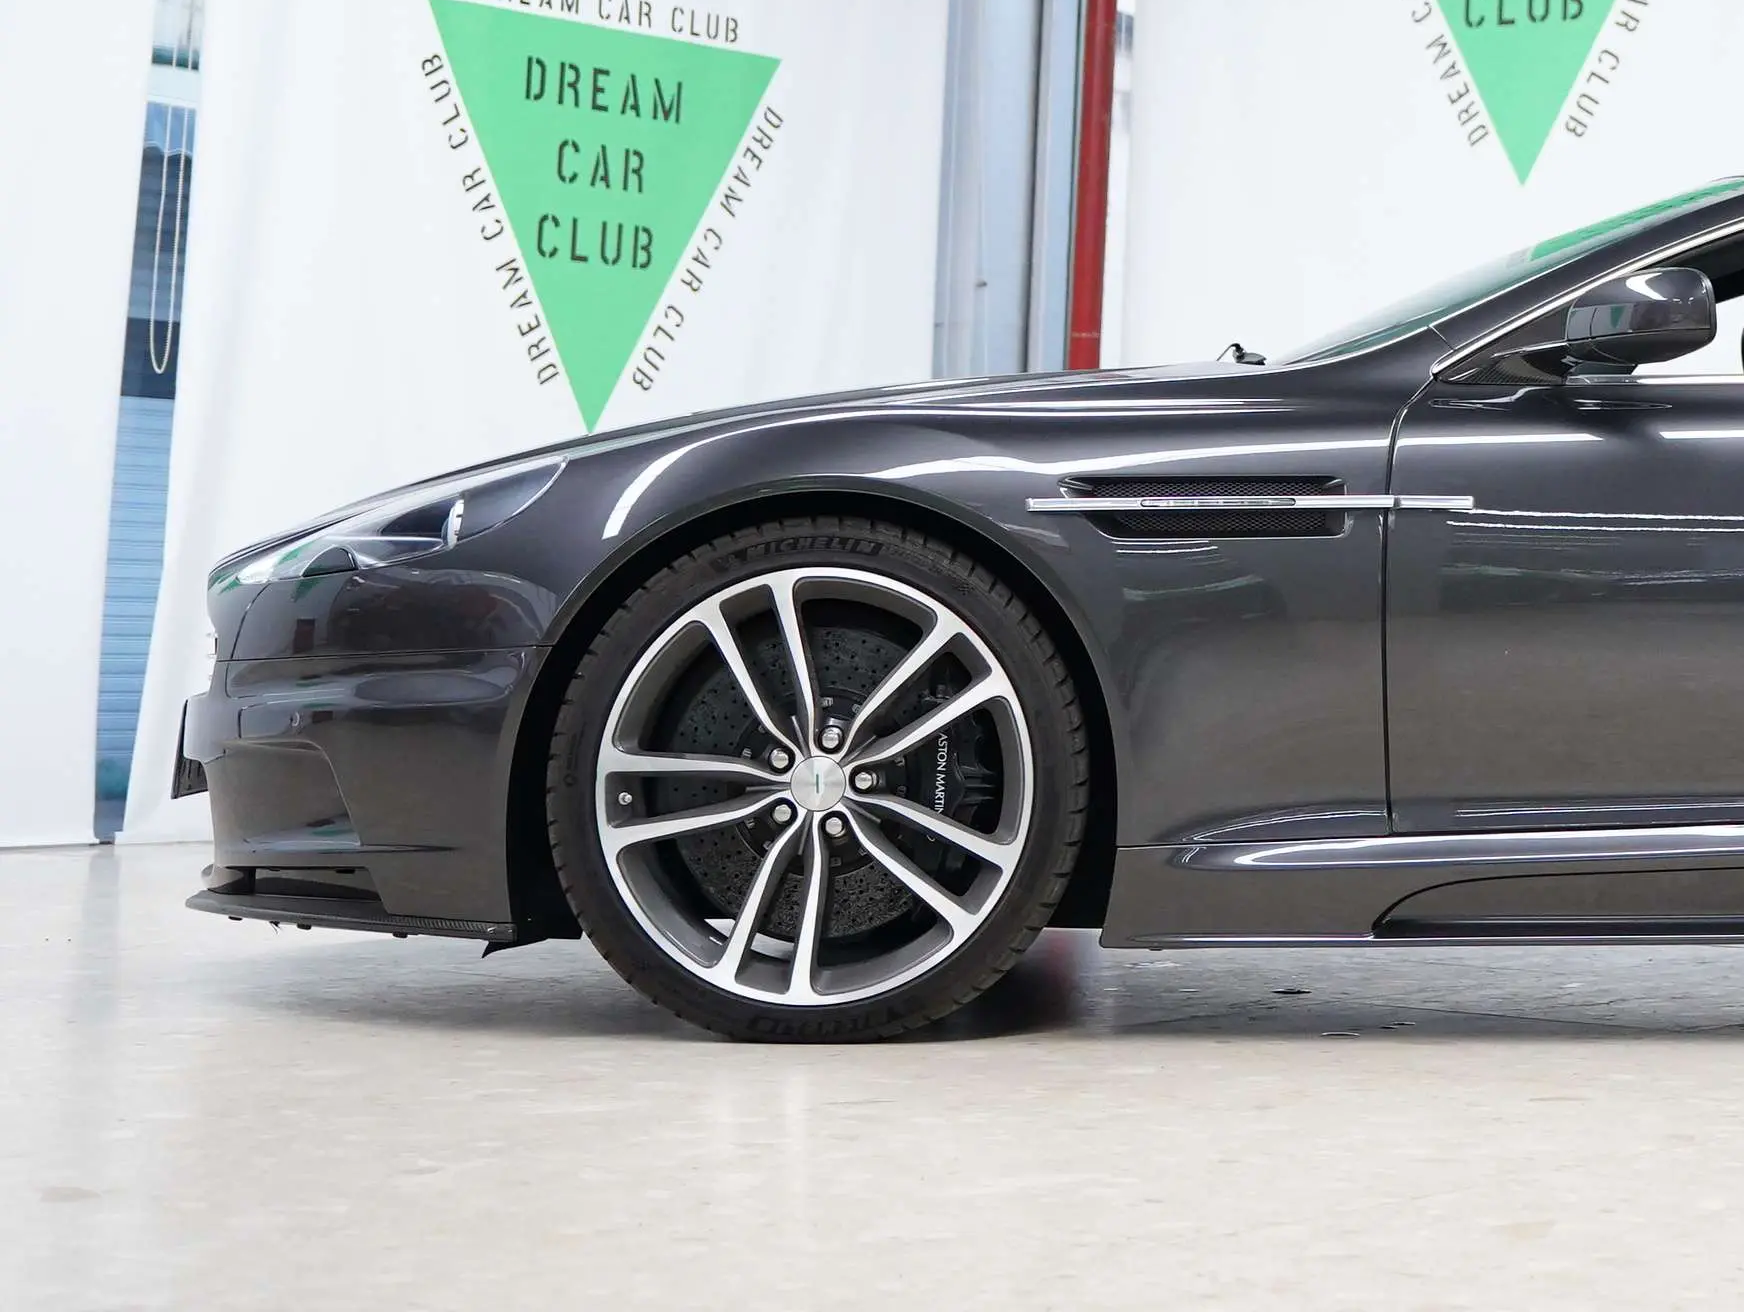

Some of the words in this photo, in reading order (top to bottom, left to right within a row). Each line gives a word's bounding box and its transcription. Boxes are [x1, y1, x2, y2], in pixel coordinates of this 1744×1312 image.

[672, 7, 738, 43] CLUB
[422, 54, 468, 149] CLUB
[525, 56, 682, 124] DREAM
[1427, 34, 1488, 146] DREAM
[1566, 50, 1619, 137] CLUB
[557, 139, 644, 193] CAR
[720, 106, 783, 218] DREAM
[462, 167, 504, 240] CAR
[537, 214, 653, 269] CLUB
[681, 228, 722, 292] CAR
[496, 258, 559, 385] DREAM
[633, 305, 684, 391] CLUB
[743, 536, 881, 558] MICHELIN
[936, 732, 948, 771] ASTON
